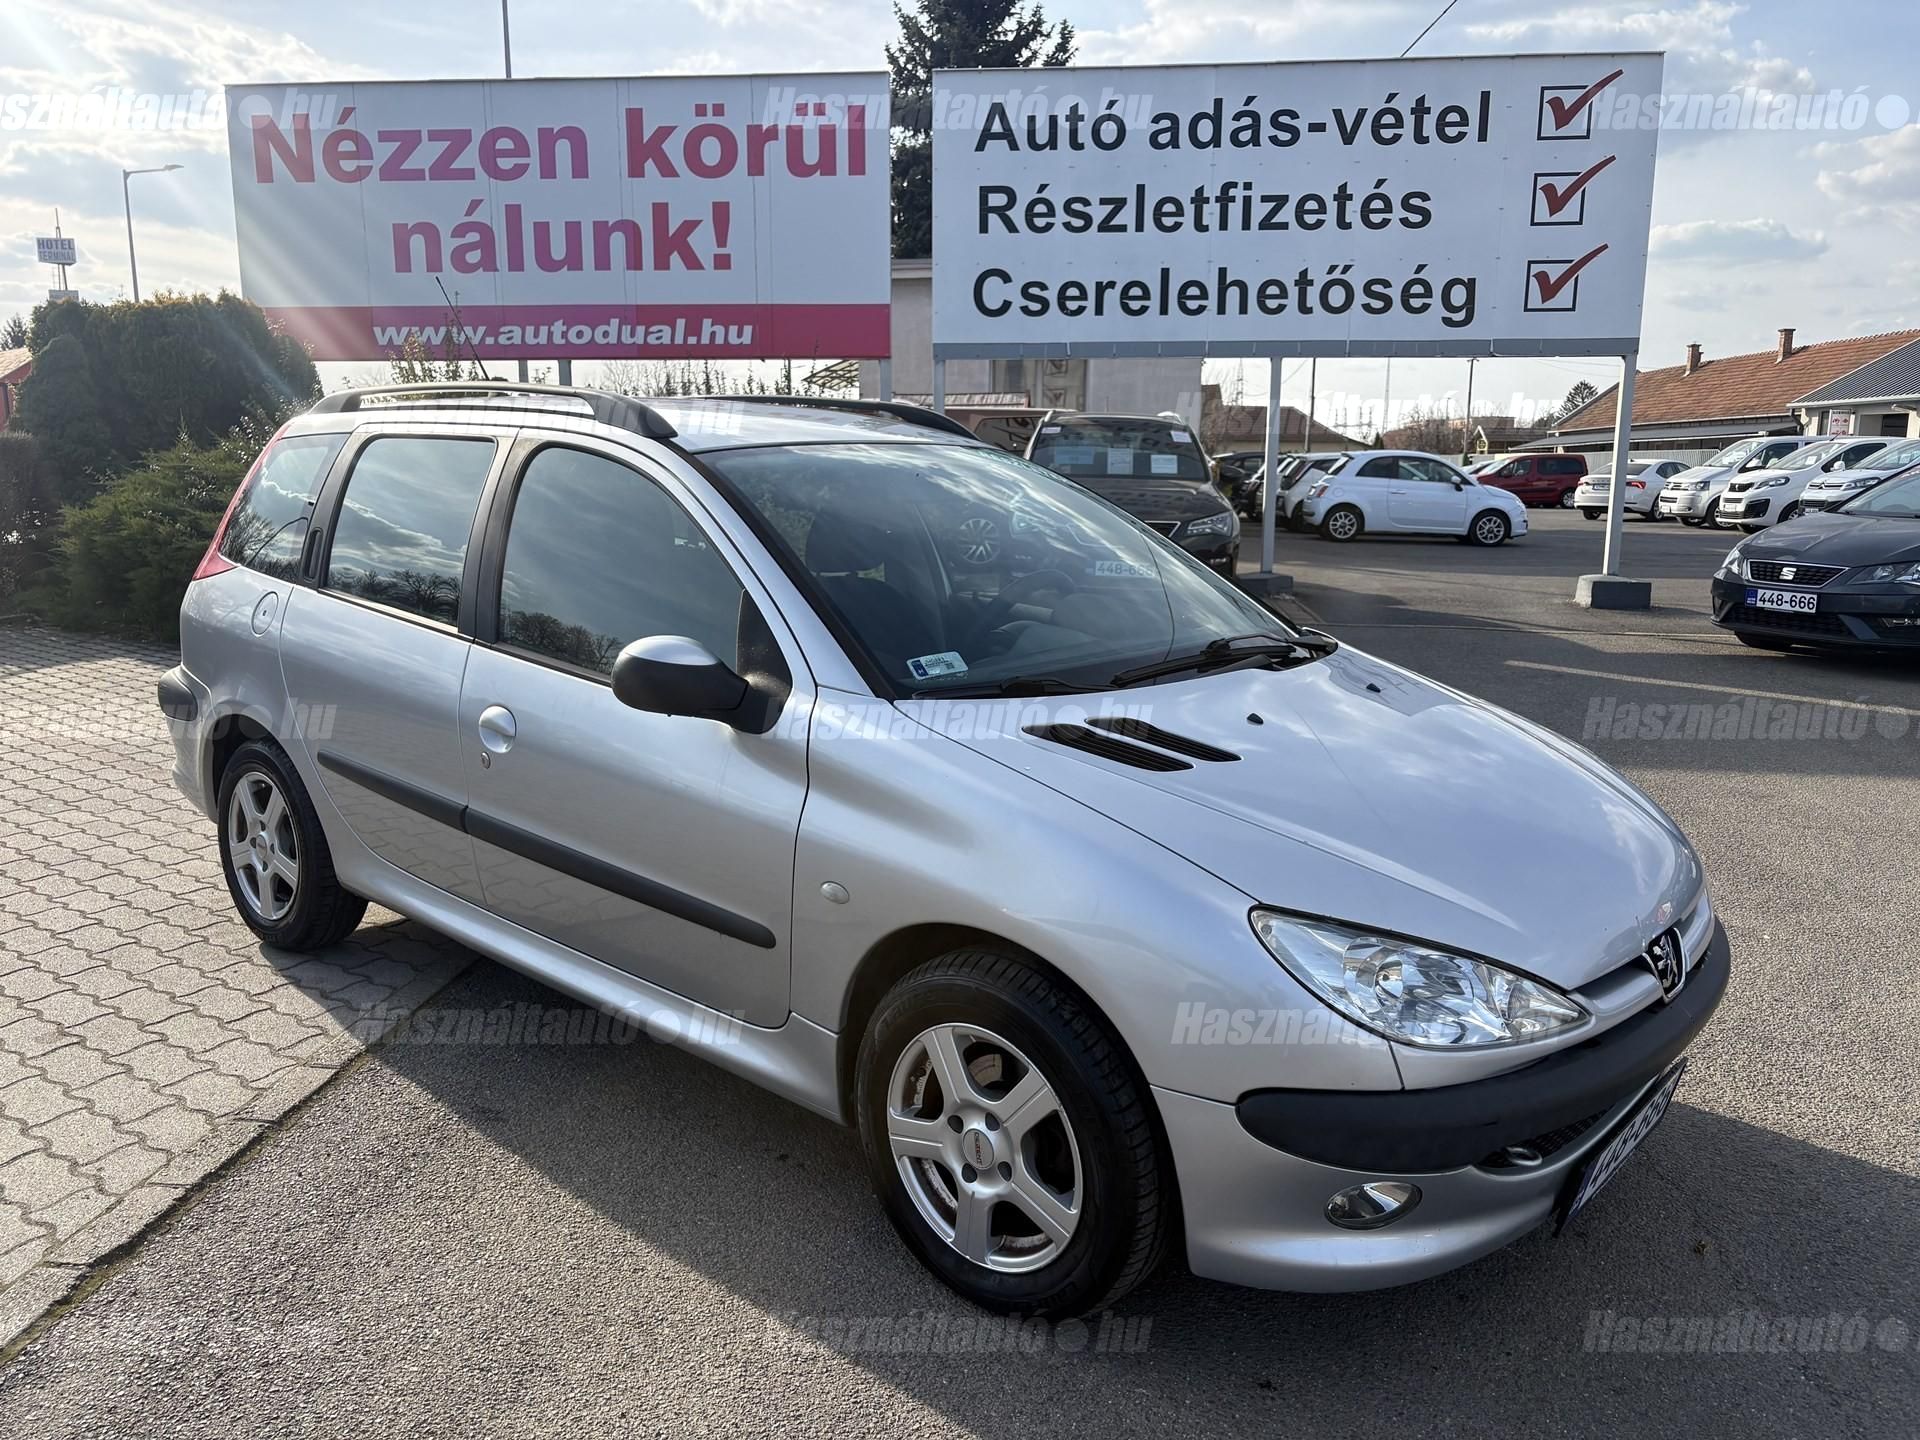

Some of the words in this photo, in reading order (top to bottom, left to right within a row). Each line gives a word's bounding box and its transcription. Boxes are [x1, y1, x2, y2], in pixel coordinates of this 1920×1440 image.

[251, 107, 589, 183] Nézzen
[625, 103, 866, 178] körül
[975, 99, 1127, 152] Autó
[1149, 90, 1491, 150] adás-vétel
[392, 199, 732, 274] nálunk!
[978, 178, 1432, 235] Részletfizetés
[37, 239, 75, 250] HOTEL
[973, 264, 1476, 328] Cserelehetőség
[373, 318, 753, 346] www.autodual.hu
[1758, 592, 1815, 610] 448-666
[1590, 1084, 1672, 1189] 448-666
